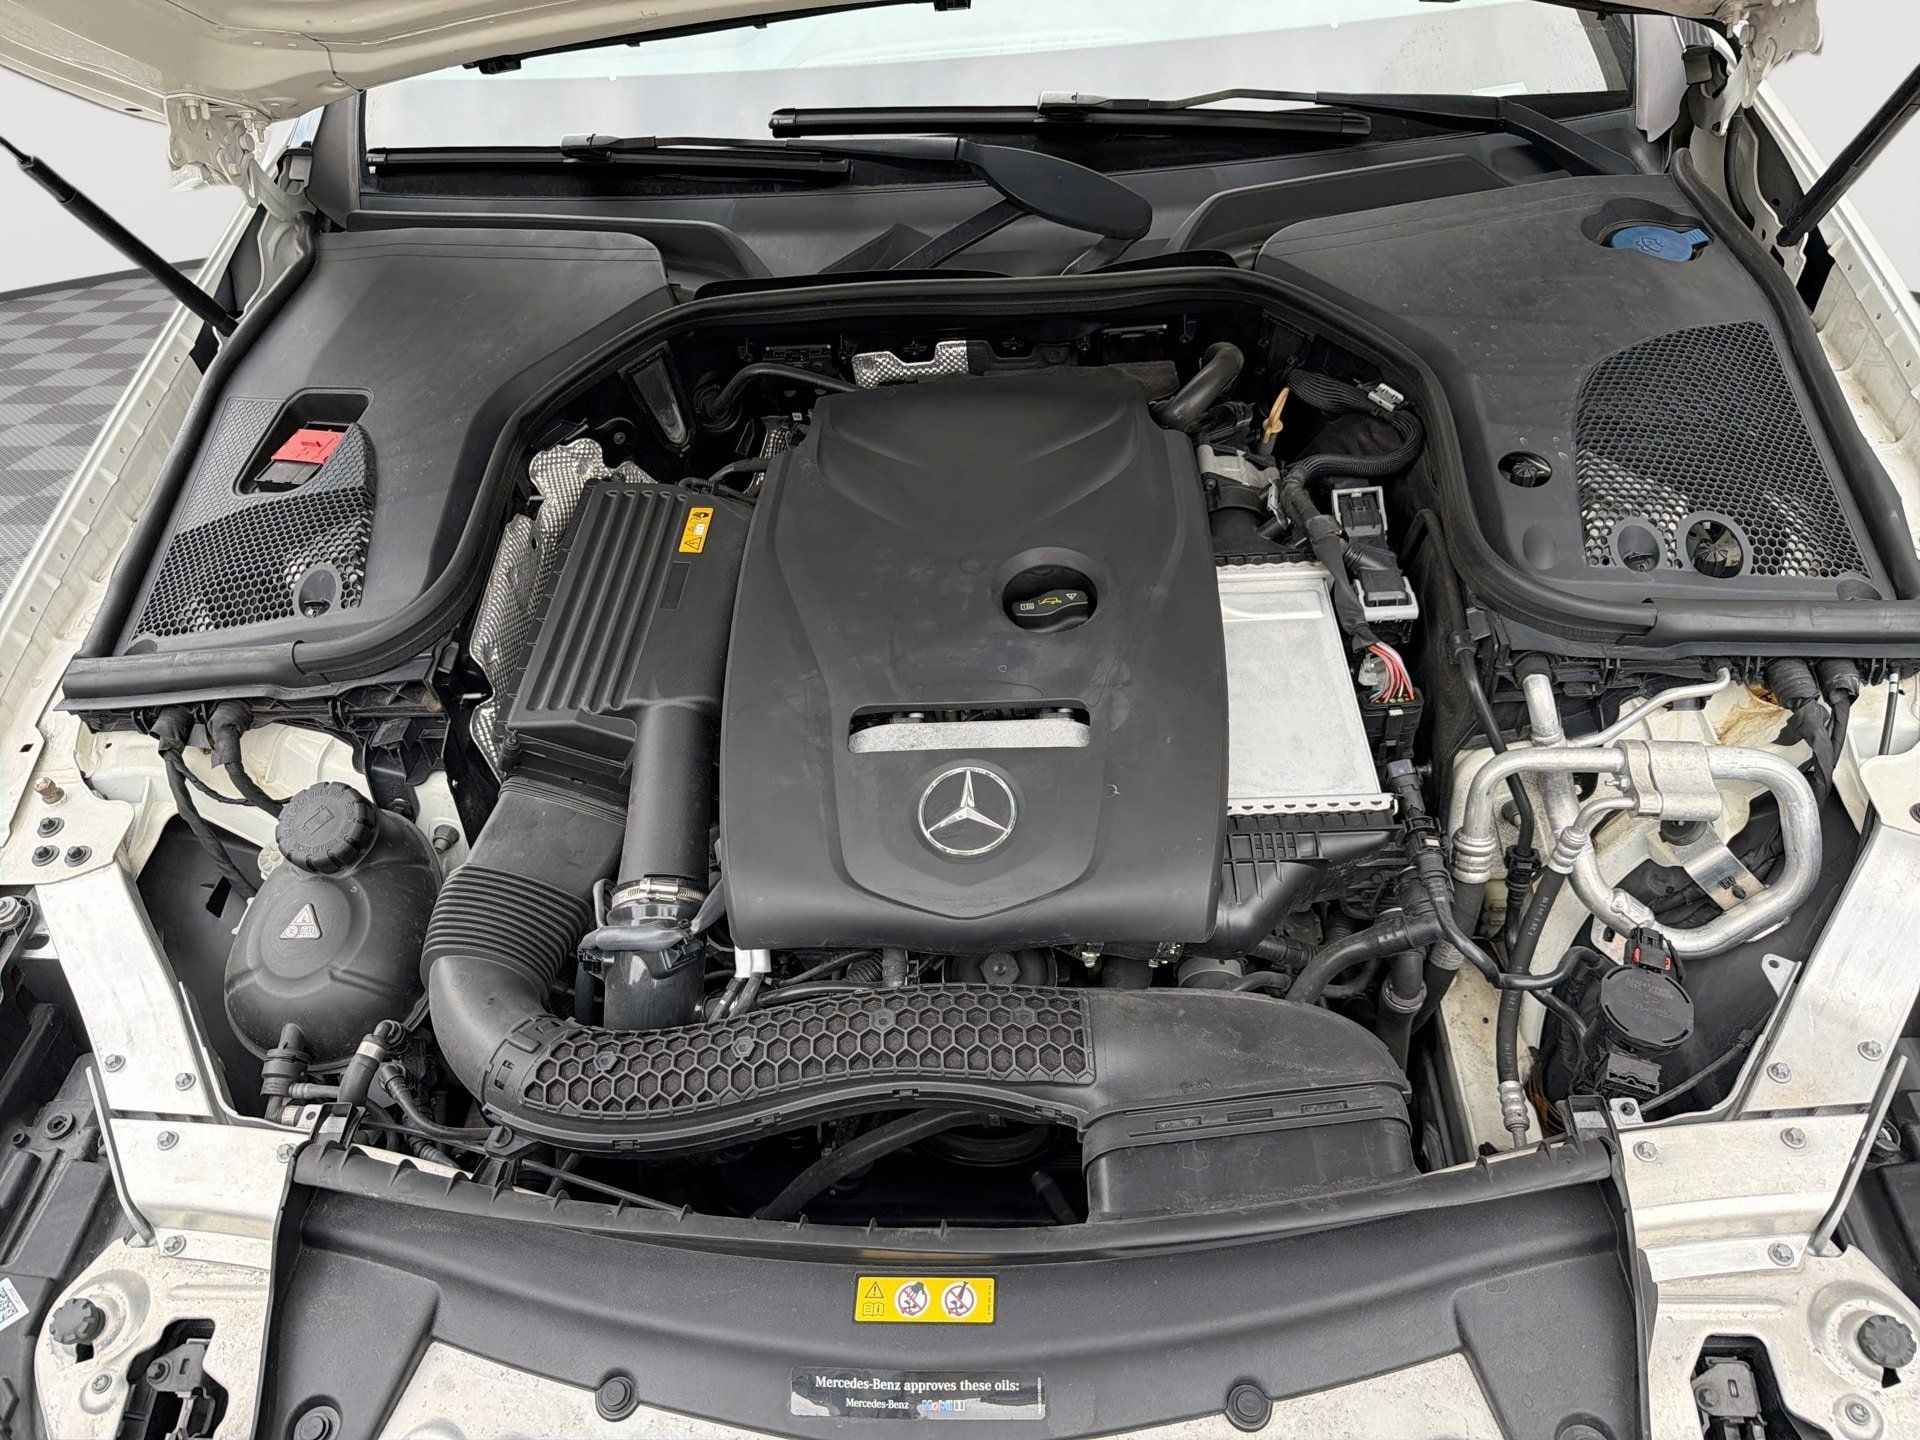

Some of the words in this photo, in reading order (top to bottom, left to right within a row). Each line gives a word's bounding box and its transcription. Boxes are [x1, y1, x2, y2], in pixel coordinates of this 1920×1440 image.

[815, 1375, 901, 1391] Mercedes-Benz
[904, 1380, 957, 1394] approves
[960, 1379, 992, 1391] these
[994, 1379, 1020, 1391] oils:
[845, 1397, 909, 1410] Mercedes-Benz
